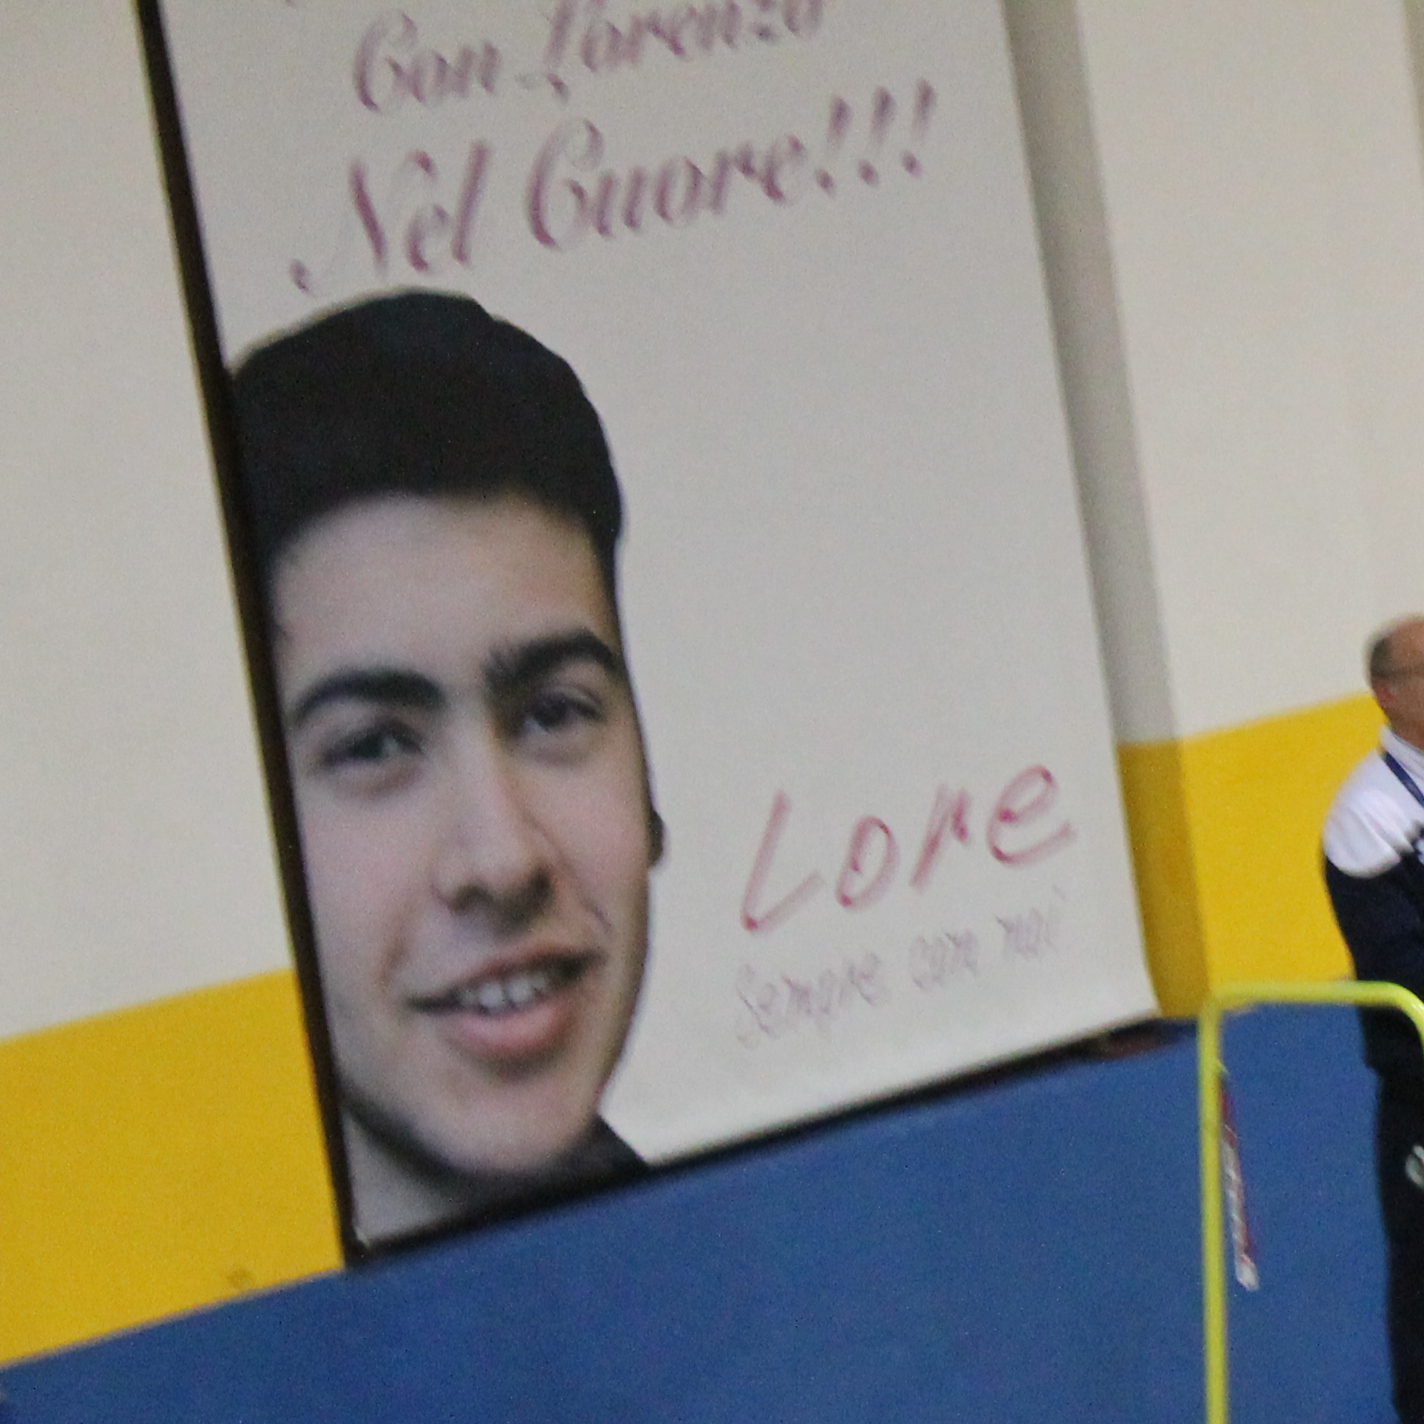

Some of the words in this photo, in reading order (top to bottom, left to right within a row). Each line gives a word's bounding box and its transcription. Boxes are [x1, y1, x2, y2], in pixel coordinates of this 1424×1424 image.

[352, 10, 502, 112] Con
[524, 78, 937, 252] Cuore!!!
[740, 764, 1078, 934] Lore
